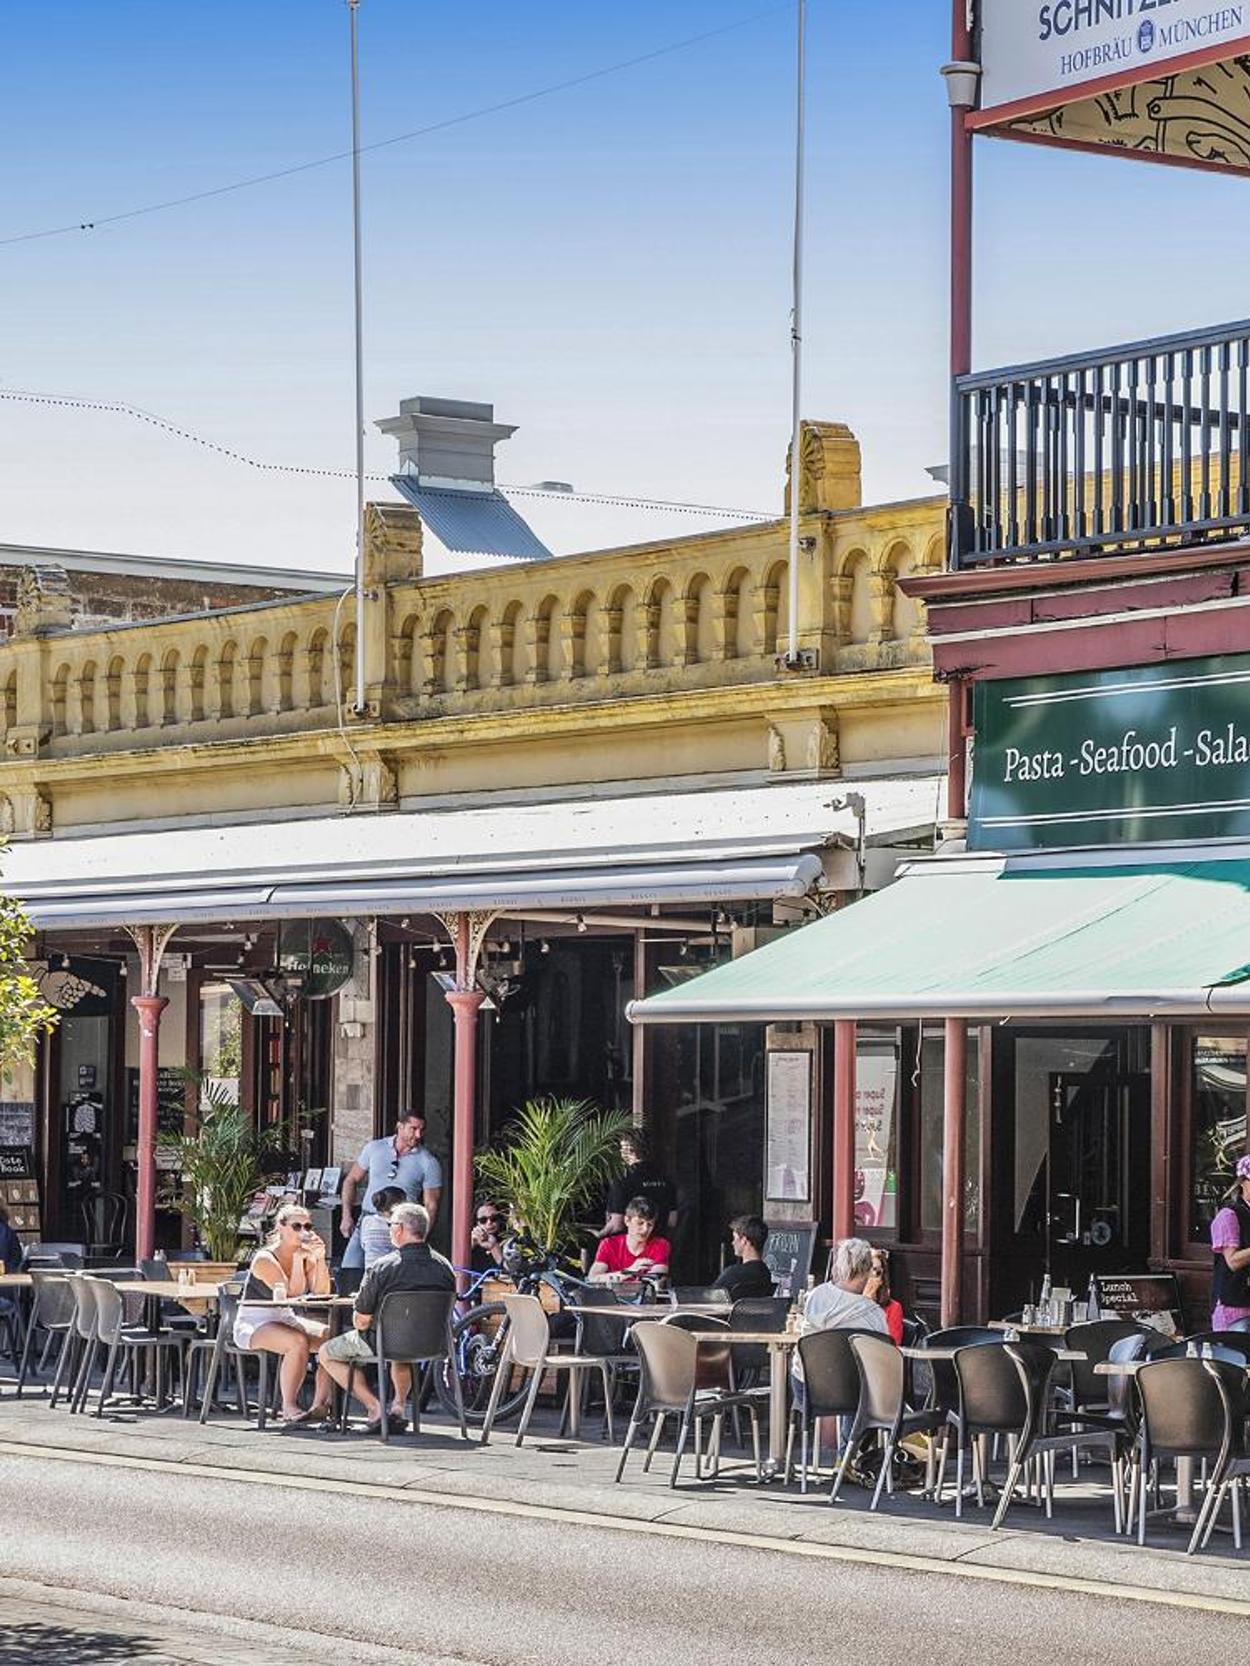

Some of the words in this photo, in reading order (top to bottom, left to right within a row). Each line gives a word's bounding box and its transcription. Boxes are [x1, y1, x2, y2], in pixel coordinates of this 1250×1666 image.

[1061, 37, 1132, 74] HOFBRÄU
[1159, 6, 1243, 47] MÜNCHEN
[1003, 747, 1065, 783] Pasta
